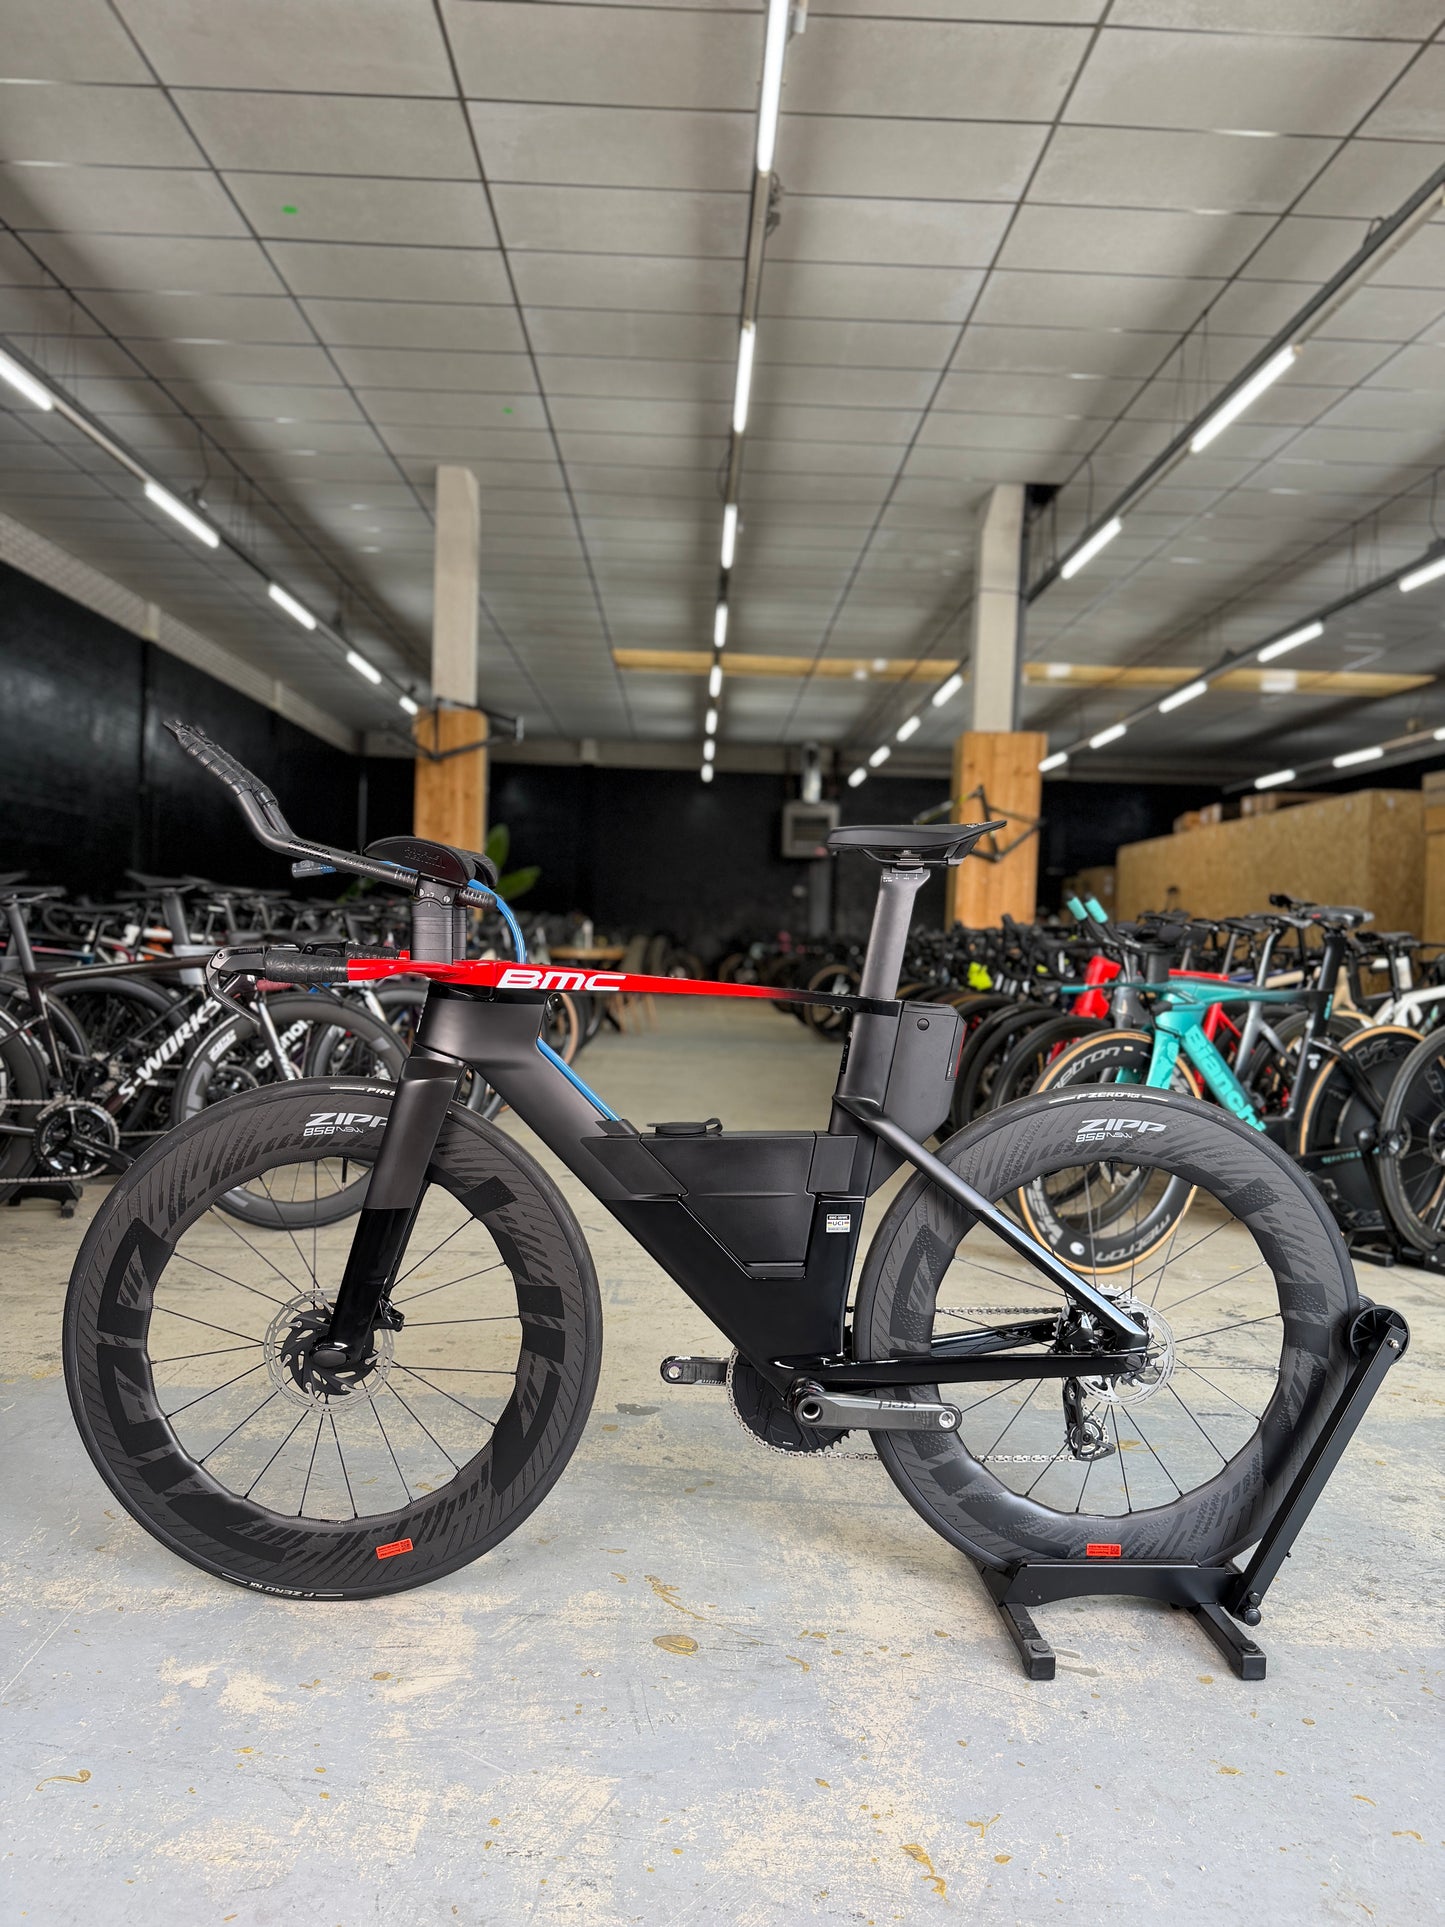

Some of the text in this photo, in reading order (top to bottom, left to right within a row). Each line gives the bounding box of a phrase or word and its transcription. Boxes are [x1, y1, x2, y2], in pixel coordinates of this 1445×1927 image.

[496, 969, 626, 991] BMC
[118, 997, 222, 1104] S-WORKS
[303, 1126, 335, 1136] 858
[1077, 1118, 1167, 1133] ZIPP
[1075, 1132, 1105, 1143] 858
